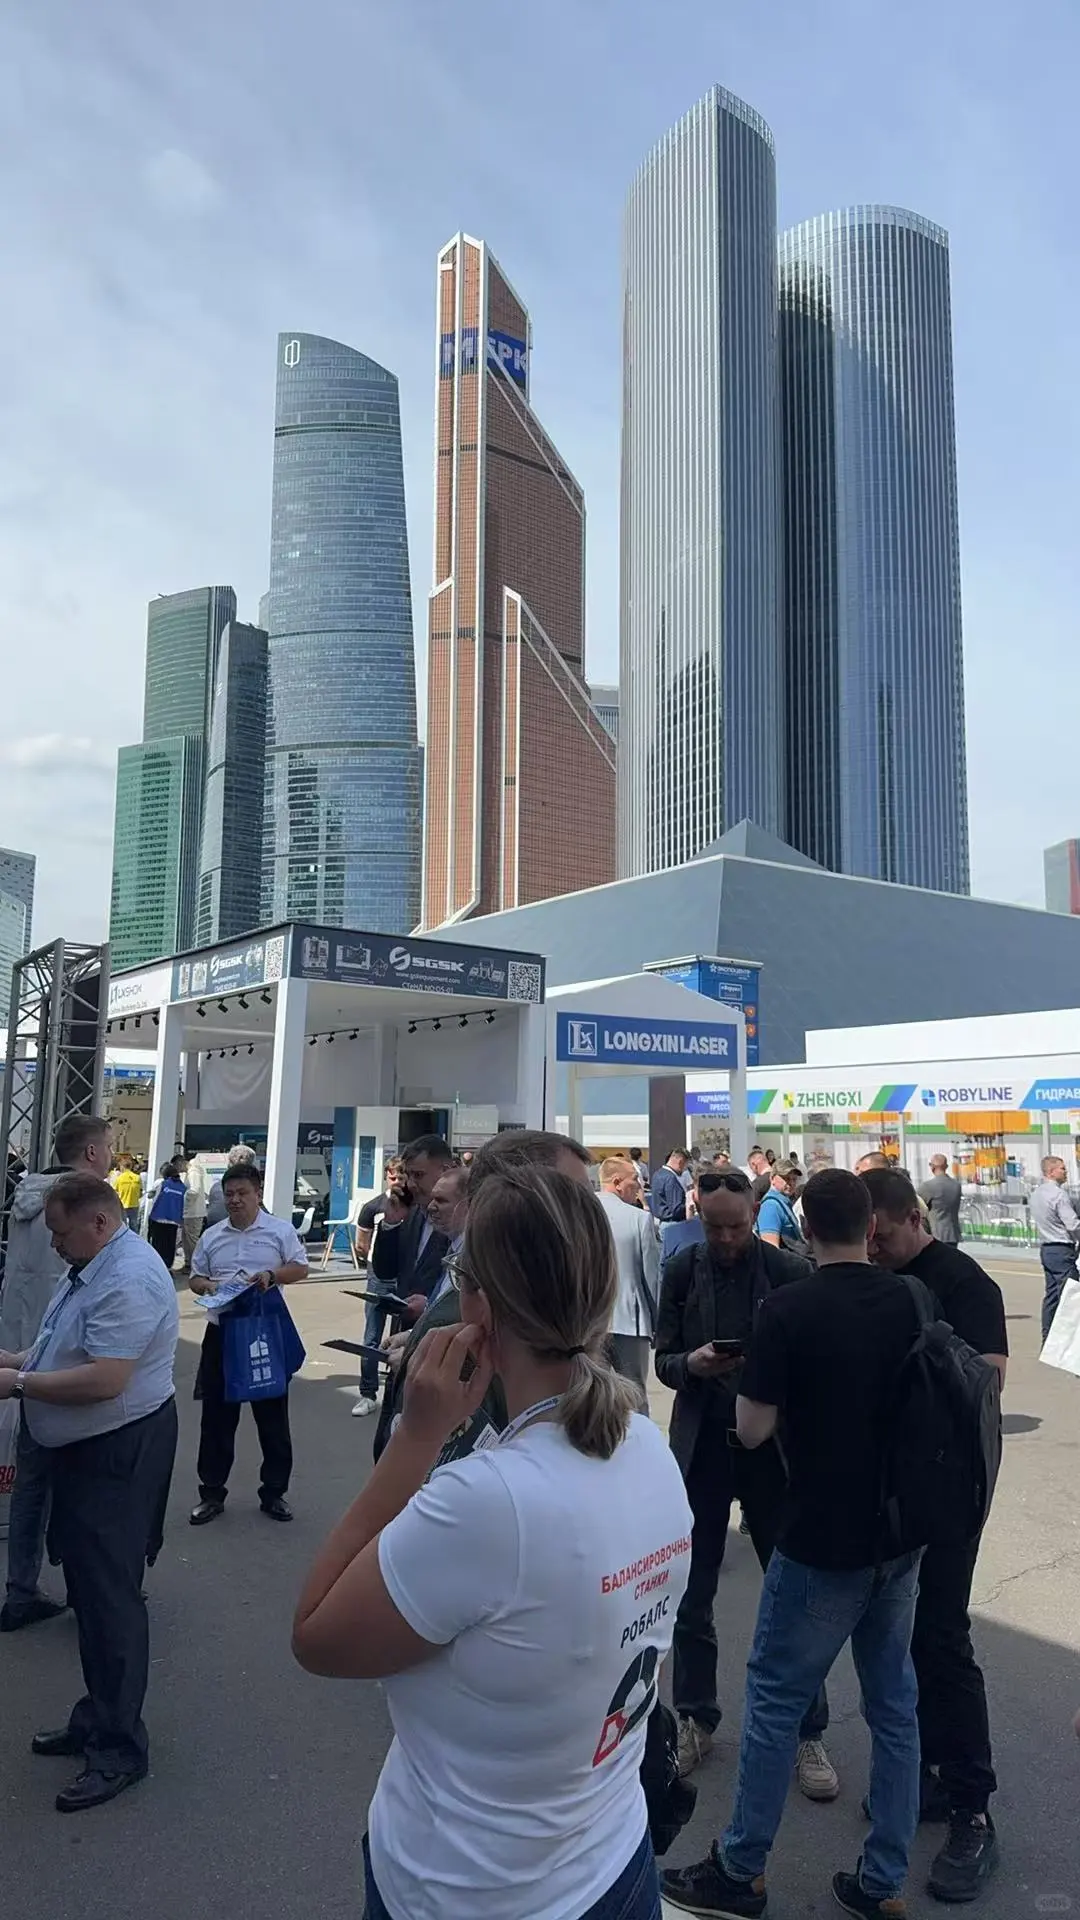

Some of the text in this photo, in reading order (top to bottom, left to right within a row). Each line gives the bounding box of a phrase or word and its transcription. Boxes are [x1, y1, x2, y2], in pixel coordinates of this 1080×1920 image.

[411, 956, 465, 973] SGSK
[797, 1091, 862, 1108] ZHENGXI
[938, 1086, 1013, 1102] ROBYLINE
[1035, 1087, 1080, 1102] ГИДРАВ
[709, 1103, 730, 1111] ПРЕСС
[601, 1534, 692, 1594] БАЛАНСИРОВОЧНЫ
[634, 1569, 670, 1601] СТАНКИ
[620, 1595, 670, 1649] РОБАЛС
